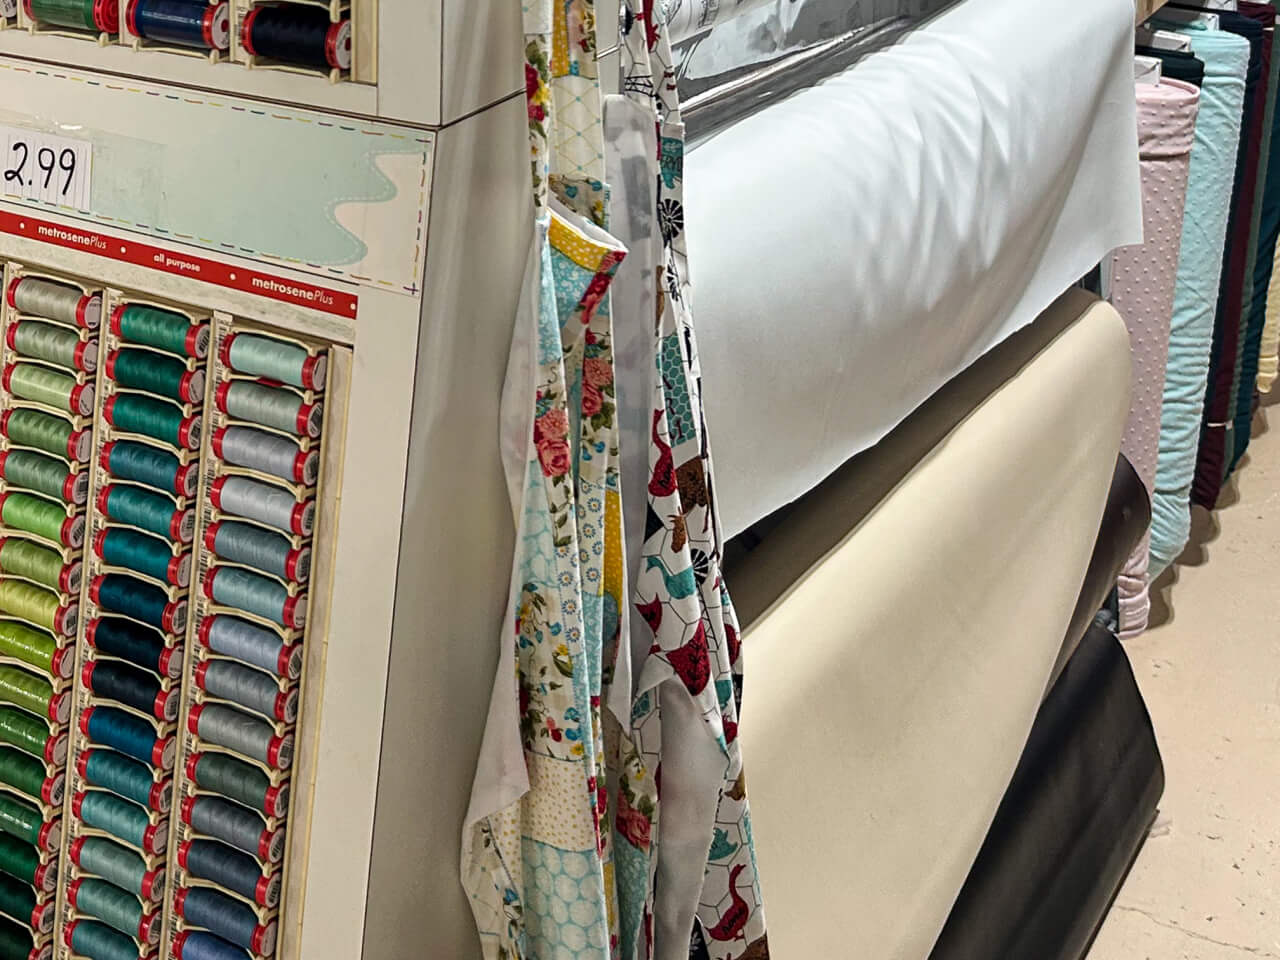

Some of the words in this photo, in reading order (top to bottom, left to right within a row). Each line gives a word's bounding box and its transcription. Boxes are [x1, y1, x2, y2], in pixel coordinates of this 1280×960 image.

[4, 141, 77, 196] 2.99
[153, 253, 164, 265] all
[166, 255, 201, 273] purpose
